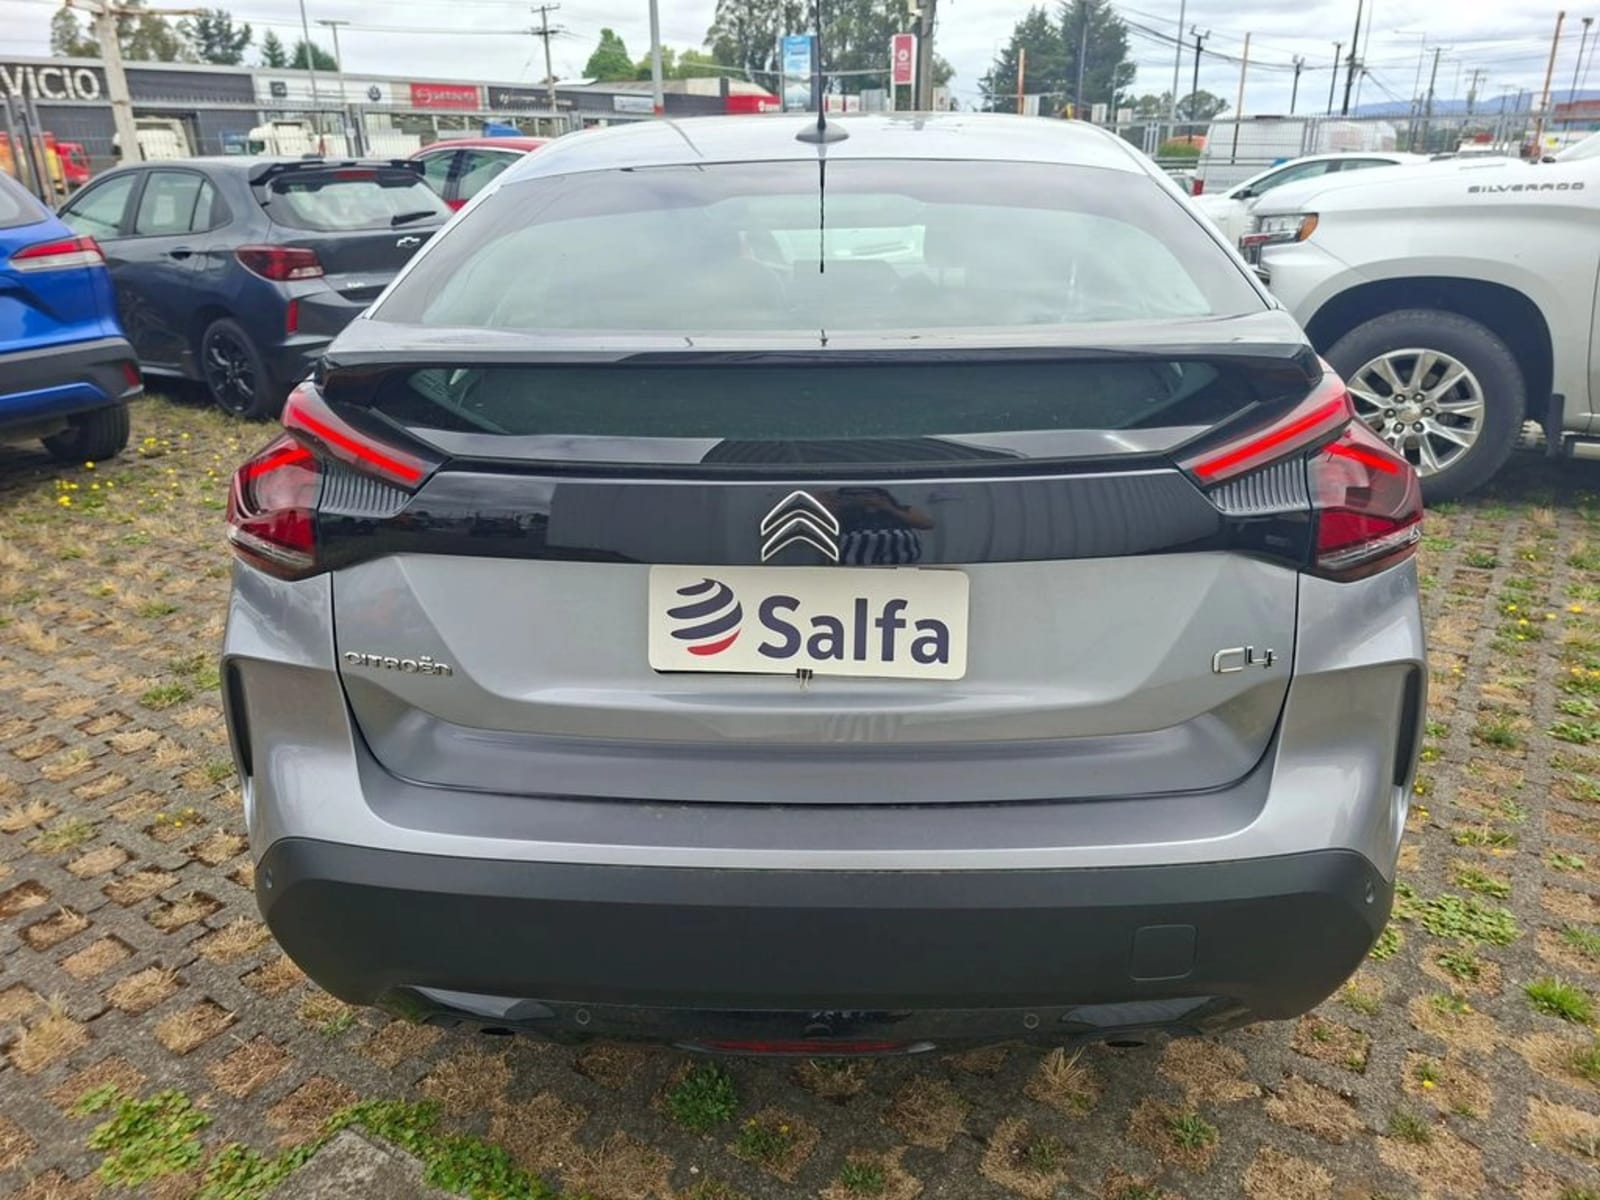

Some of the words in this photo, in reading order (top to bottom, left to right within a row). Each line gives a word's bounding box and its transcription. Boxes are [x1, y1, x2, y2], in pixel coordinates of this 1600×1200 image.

[0, 65, 101, 100] VICIO
[1467, 182, 1585, 194] SILVERADO
[757, 594, 950, 665] Salfa
[1212, 645, 1278, 674] C4
